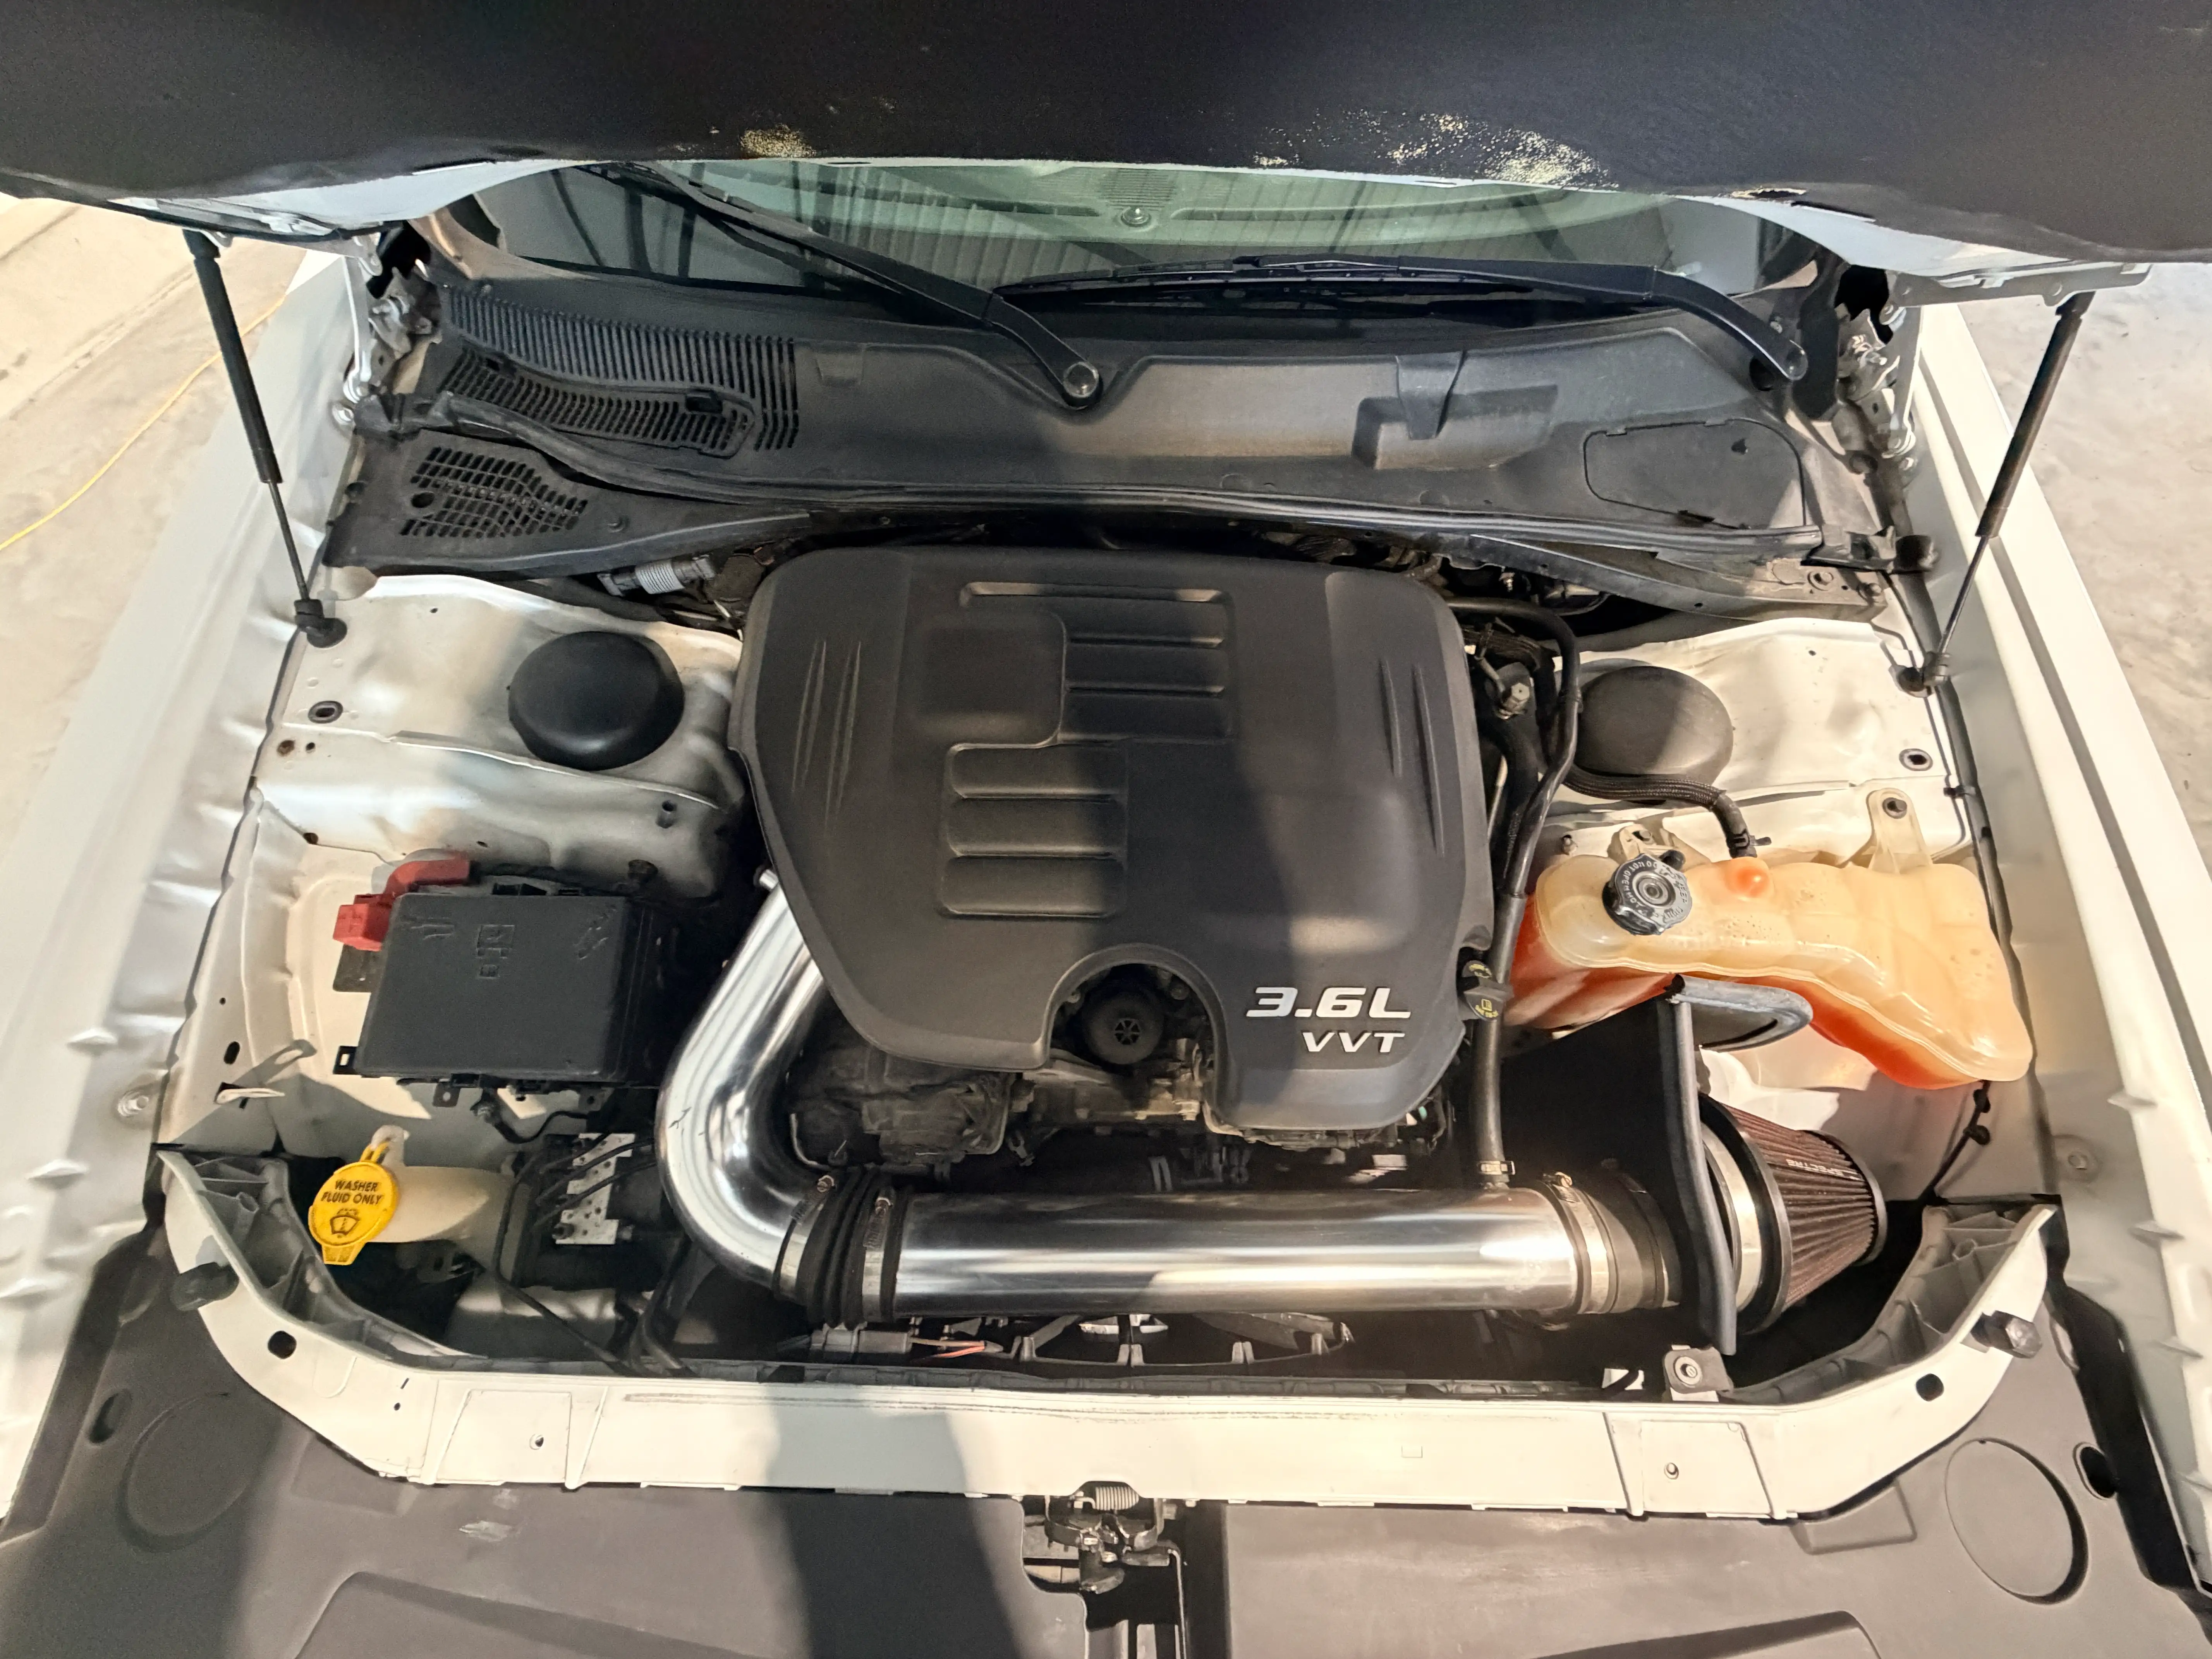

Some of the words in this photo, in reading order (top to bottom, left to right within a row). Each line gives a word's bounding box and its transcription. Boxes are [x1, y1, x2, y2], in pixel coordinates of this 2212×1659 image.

[1246, 987, 1411, 1018] 3.6L
[1302, 1032, 1405, 1053] VVT
[1786, 1159, 1845, 1177] SPECTRE
[335, 1180, 378, 1192] WASHER
[321, 1192, 350, 1203] FLUID
[353, 1193, 383, 1205] ONLY
